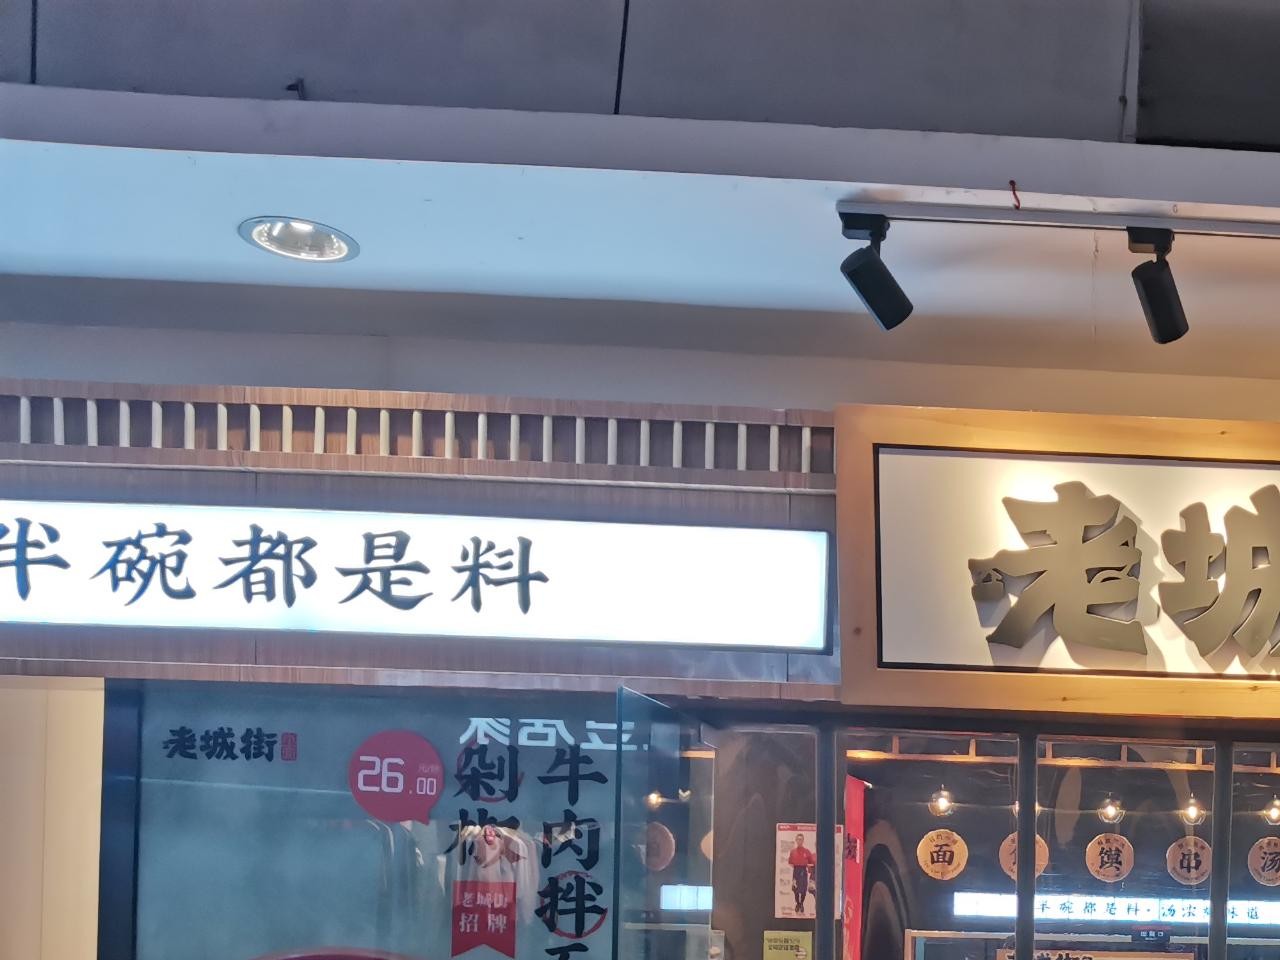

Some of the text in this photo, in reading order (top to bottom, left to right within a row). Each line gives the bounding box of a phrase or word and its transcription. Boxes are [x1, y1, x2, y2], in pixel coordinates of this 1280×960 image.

[0, 517, 550, 614] 半碗都是料
[162, 726, 278, 762] 老城街
[357, 755, 437, 796] 26.00
[930, 843, 955, 866] 面
[1179, 849, 1202, 873] 串
